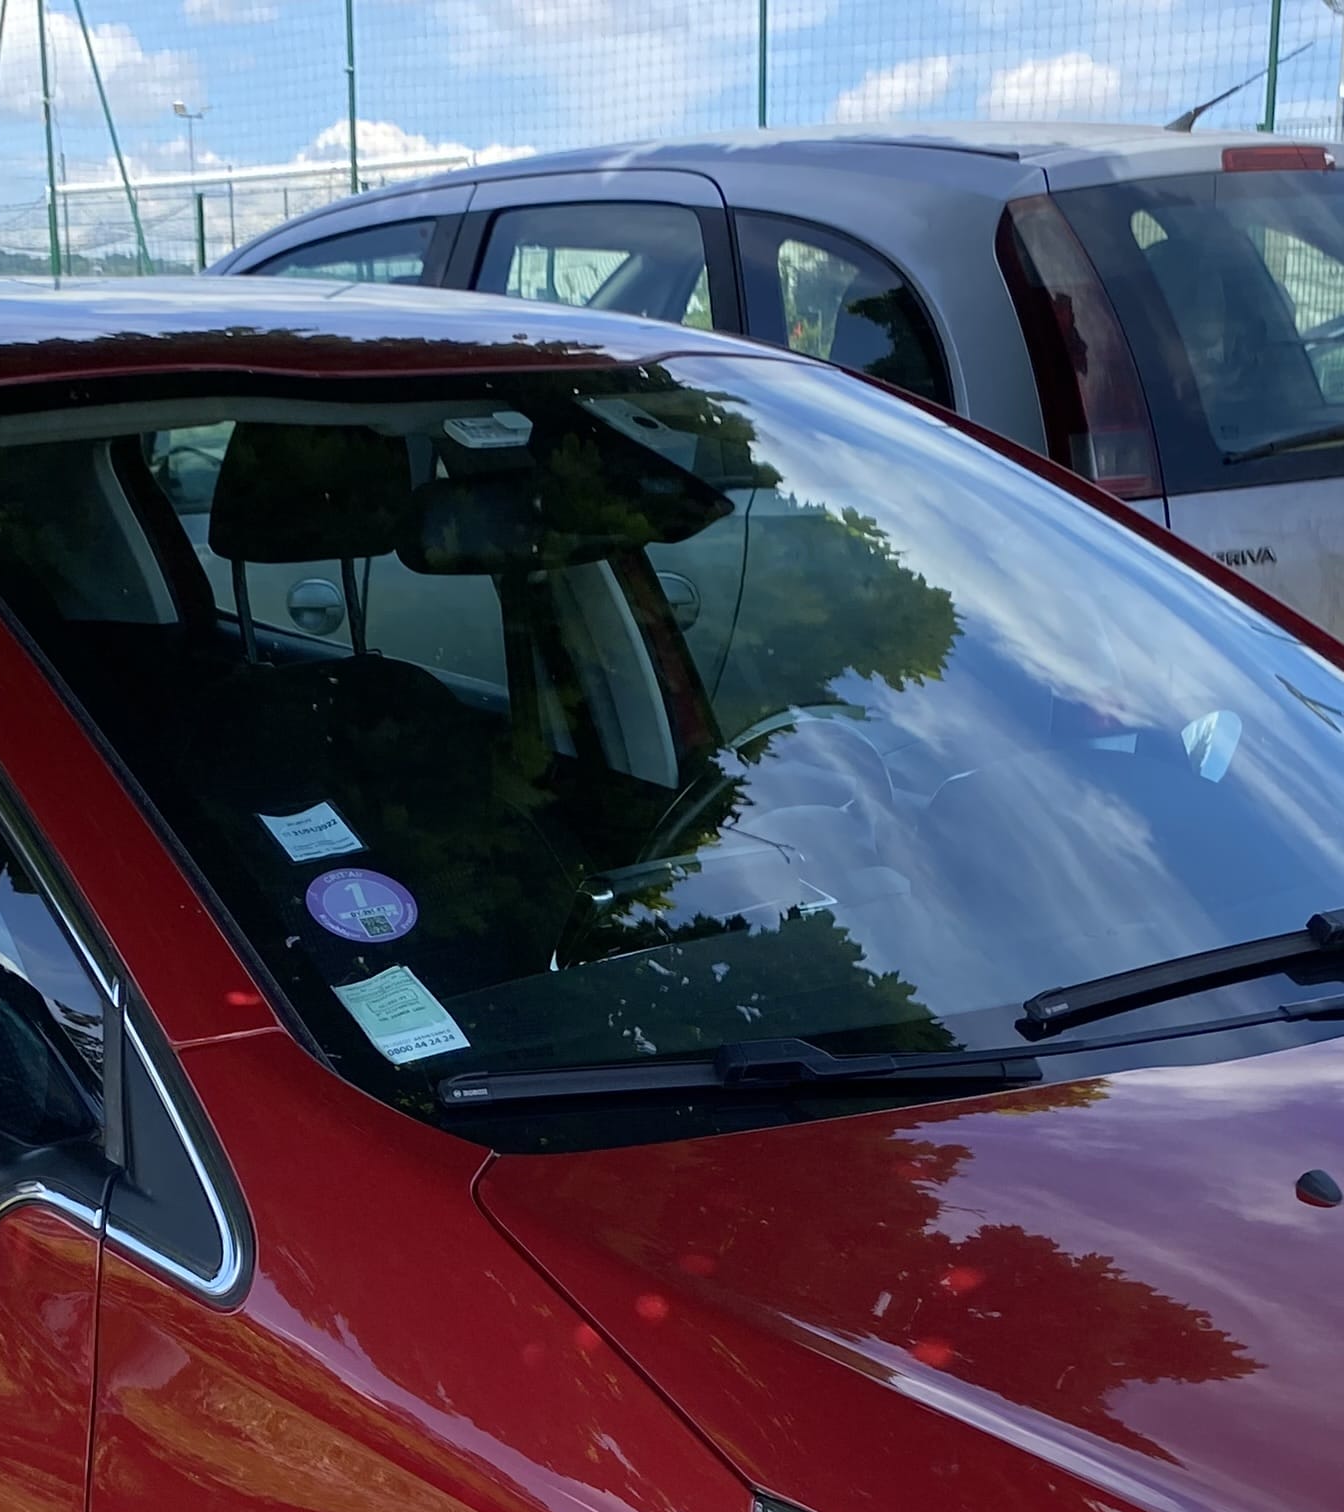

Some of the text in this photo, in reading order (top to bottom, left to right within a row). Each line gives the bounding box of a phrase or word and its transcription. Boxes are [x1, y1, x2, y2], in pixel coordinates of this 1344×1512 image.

[1212, 544, 1278, 567] ERIVA
[344, 882, 368, 908] 1
[387, 1034, 456, 1057] 0800 44 24 24
